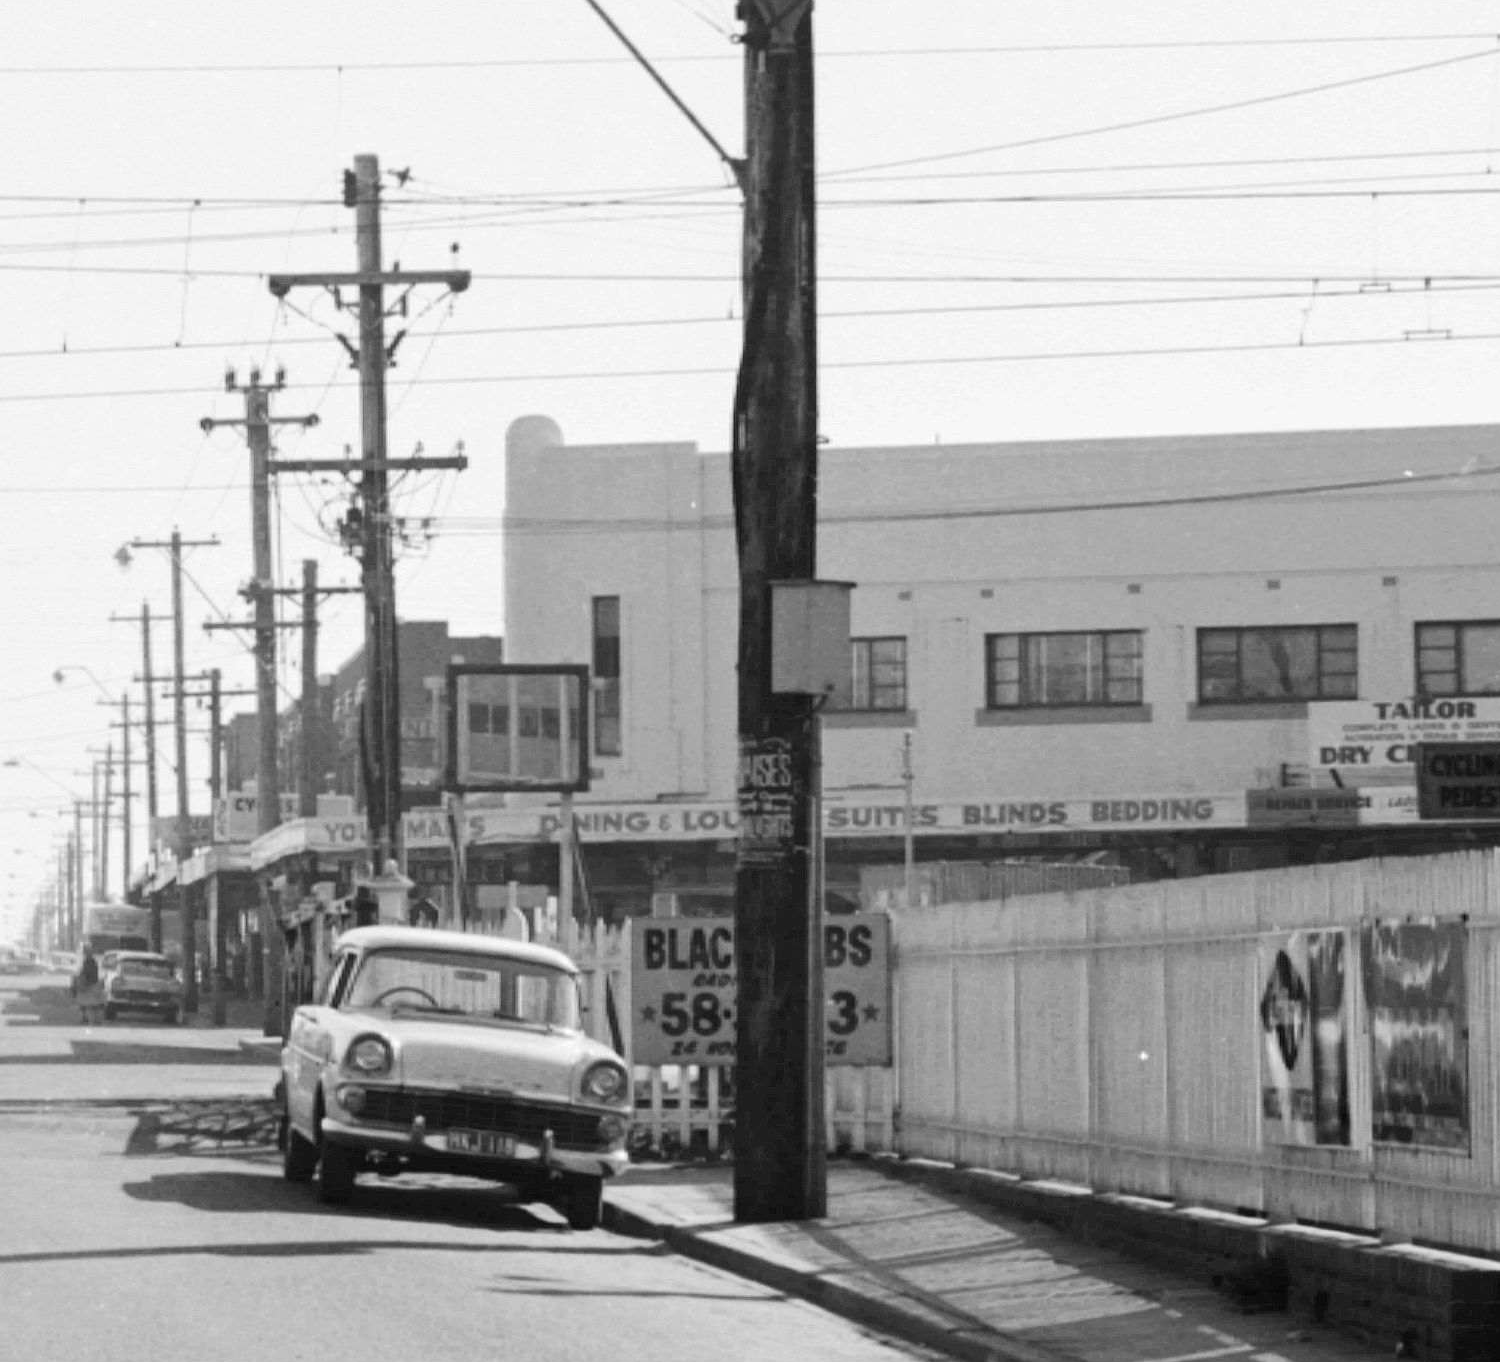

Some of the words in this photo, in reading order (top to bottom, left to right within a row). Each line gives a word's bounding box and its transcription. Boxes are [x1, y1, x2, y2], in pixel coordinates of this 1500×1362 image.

[1373, 701, 1477, 721] TAILOR
[1319, 745, 1375, 766] DRY
[540, 810, 650, 836] DNING
[827, 805, 939, 828] SUITES
[962, 800, 1068, 827] BLINDS
[1090, 798, 1215, 824] BEDDING
[670, 1040, 698, 1056] 24
